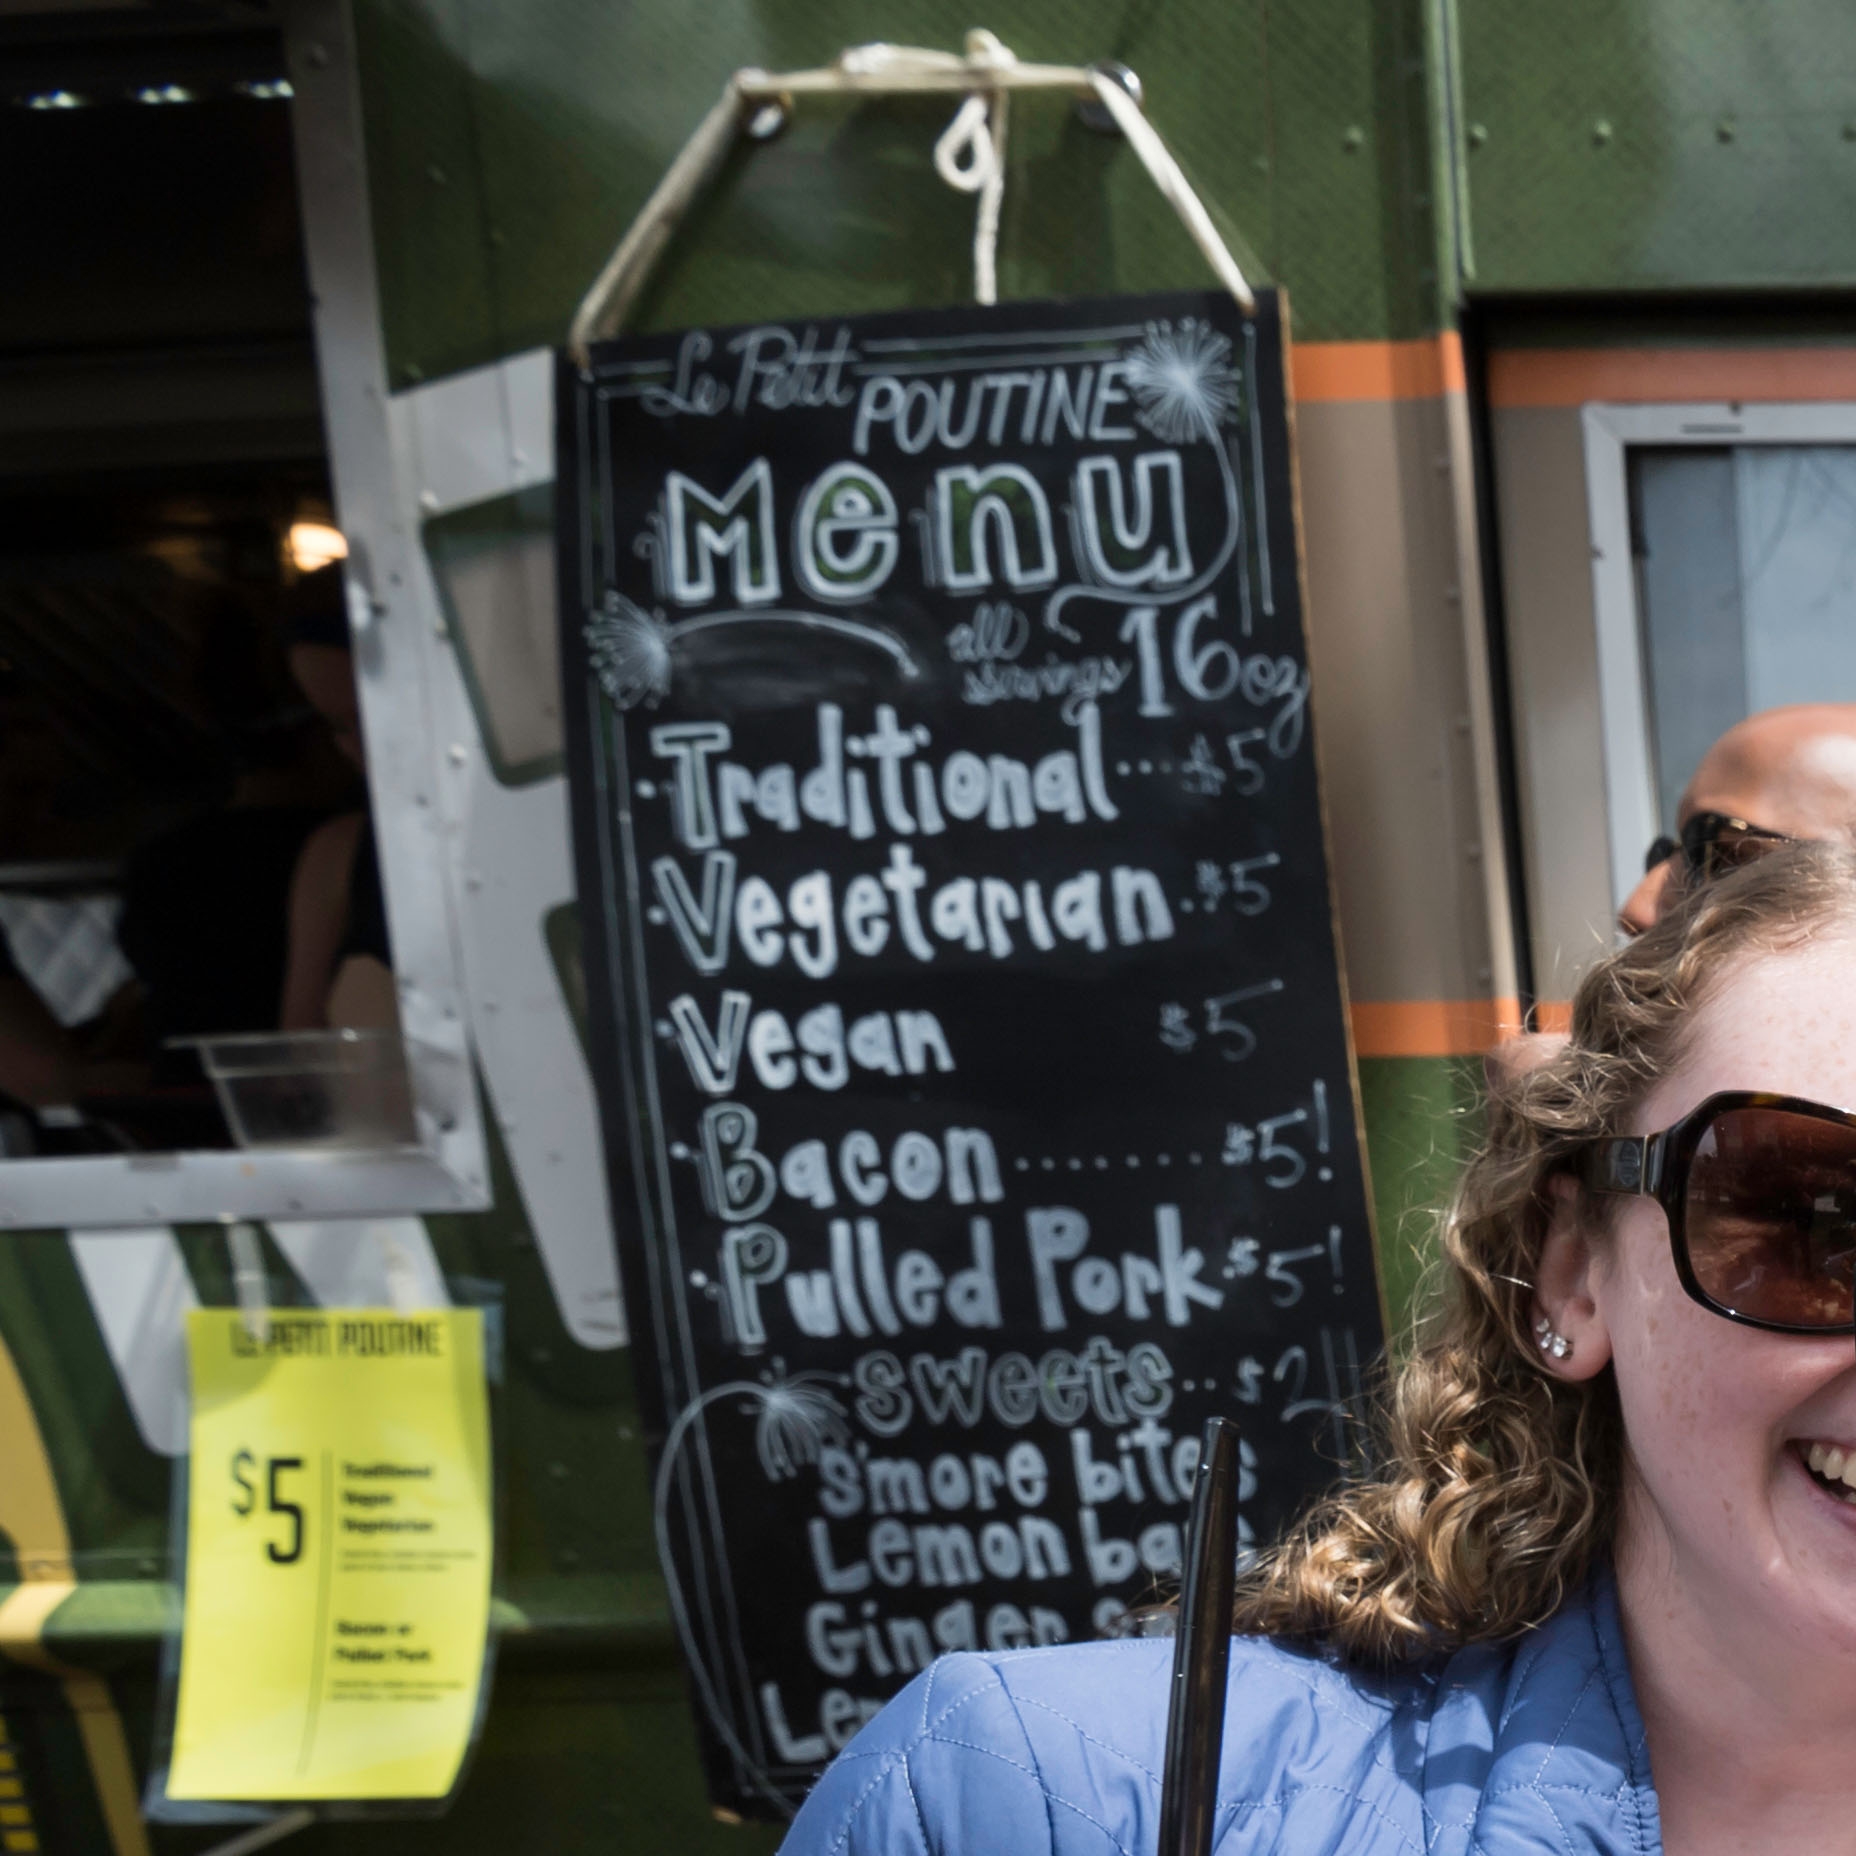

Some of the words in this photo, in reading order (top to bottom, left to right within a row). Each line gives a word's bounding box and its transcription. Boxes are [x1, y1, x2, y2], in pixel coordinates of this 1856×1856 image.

[853, 363, 1137, 455] POUTINE
[651, 702, 1120, 850] Traditional
[1181, 727, 1266, 797] $5
[653, 844, 1176, 979] Vegetarian
[1195, 853, 1280, 915] $5
[669, 991, 955, 1096] Vegan
[1158, 977, 1285, 1063] $5
[698, 1103, 1005, 1221] Bacon
[720, 1214, 1002, 1348] Pulled
[1024, 1204, 1225, 1332] Pork
[807, 1499, 1070, 1593] Lemon
